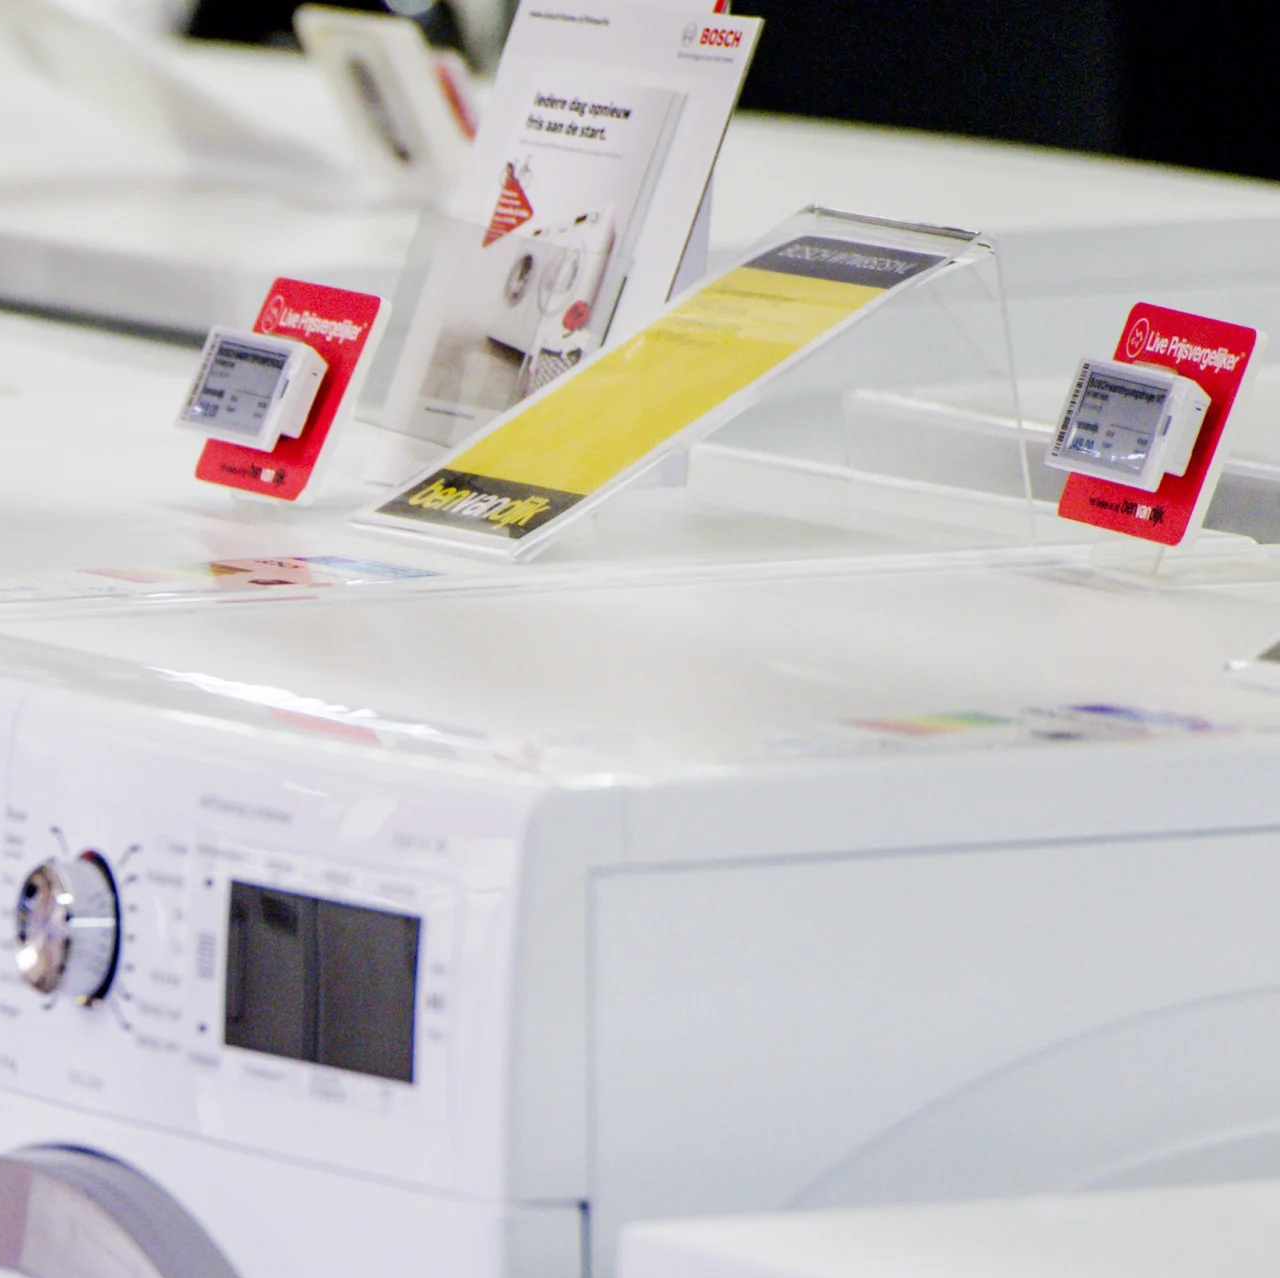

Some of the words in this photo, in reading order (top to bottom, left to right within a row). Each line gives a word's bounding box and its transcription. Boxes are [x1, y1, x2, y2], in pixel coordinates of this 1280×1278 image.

[699, 27, 743, 48] BOSCH
[534, 92, 566, 111] Iedere
[568, 97, 588, 118] dag
[589, 101, 632, 120] opnieuw
[545, 119, 565, 135] aan
[565, 120, 579, 136] de
[579, 123, 607, 141] start.
[1145, 330, 1167, 355] Live
[1167, 335, 1241, 374] Prijsvergelijker
[407, 477, 552, 531] benvandijk
